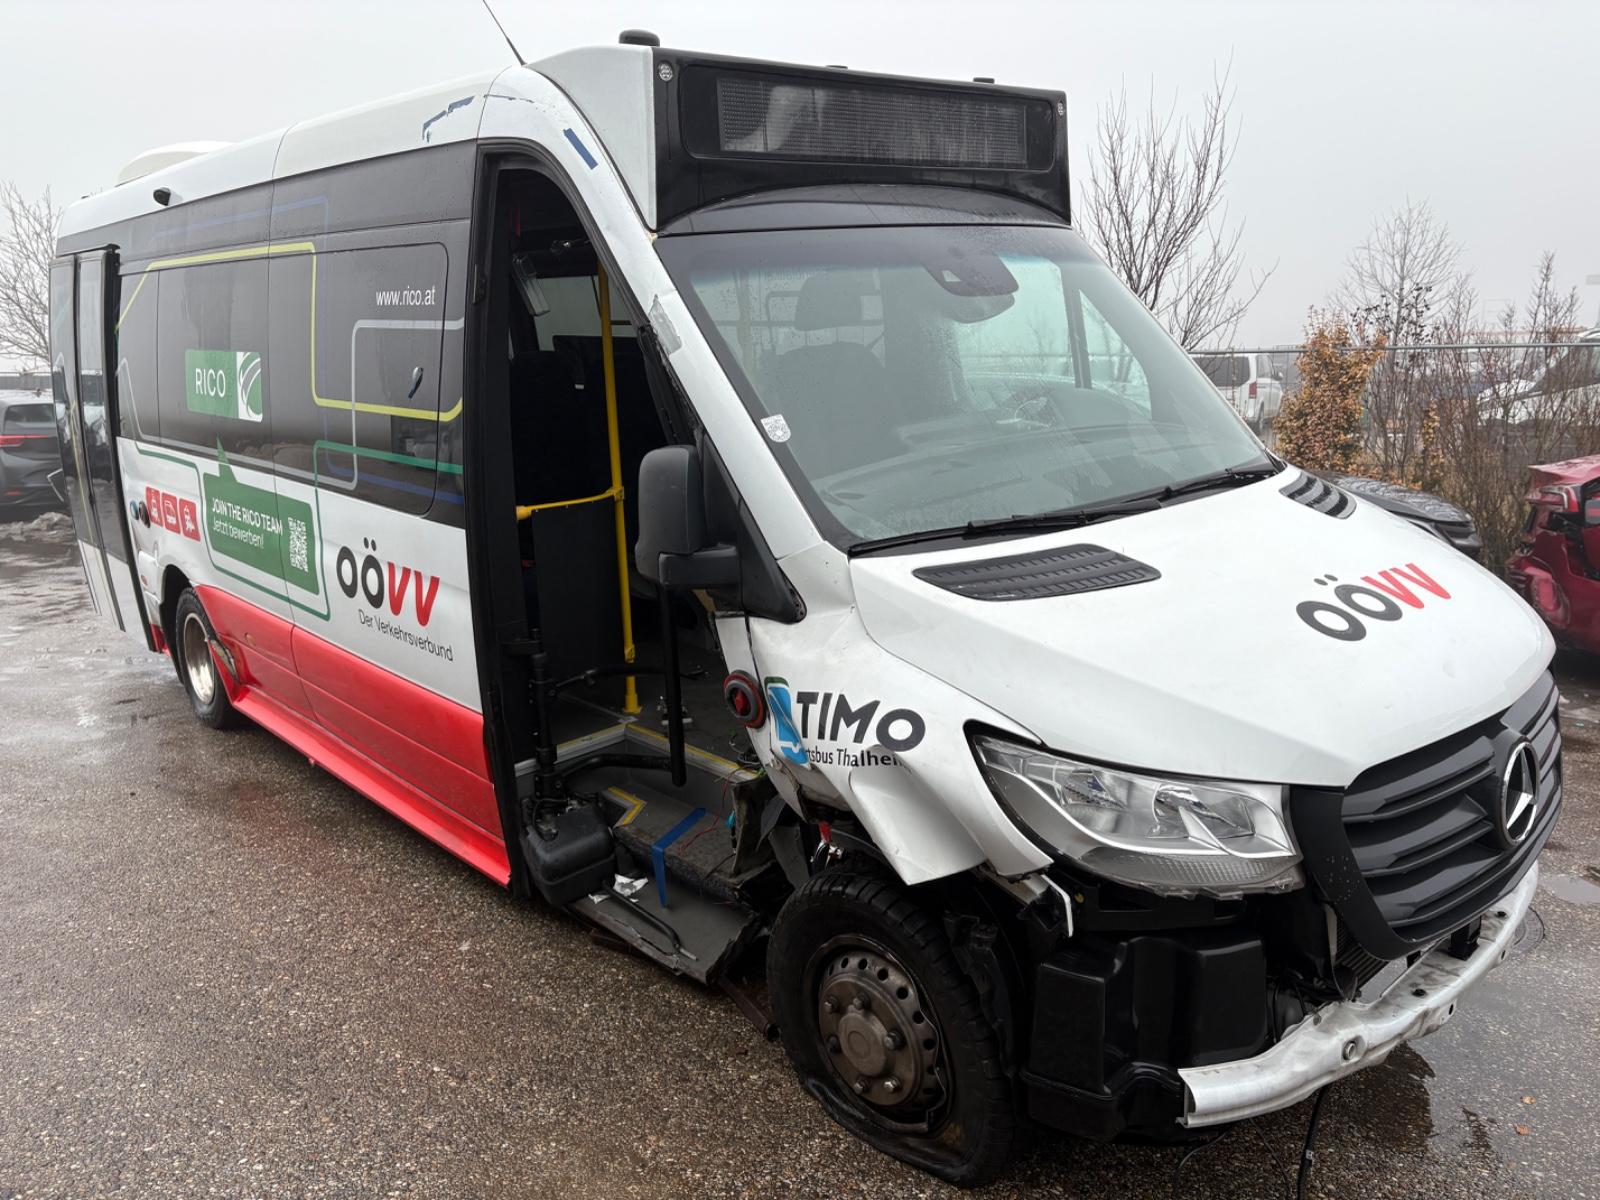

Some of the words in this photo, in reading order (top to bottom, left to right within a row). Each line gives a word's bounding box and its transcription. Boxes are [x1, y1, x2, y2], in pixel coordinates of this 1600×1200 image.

[375, 285, 435, 306] www.rico.at
[195, 367, 226, 398] RICO
[212, 498, 228, 516] JOIN
[228, 502, 242, 520] THE
[242, 507, 260, 527] RICO
[260, 513, 283, 536] TEAM
[212, 516, 229, 534] Jetzt
[229, 522, 264, 549] bewerben!
[358, 609, 374, 628] Der
[375, 614, 453, 661] Verkehrsverbund
[796, 691, 926, 752] TIMO
